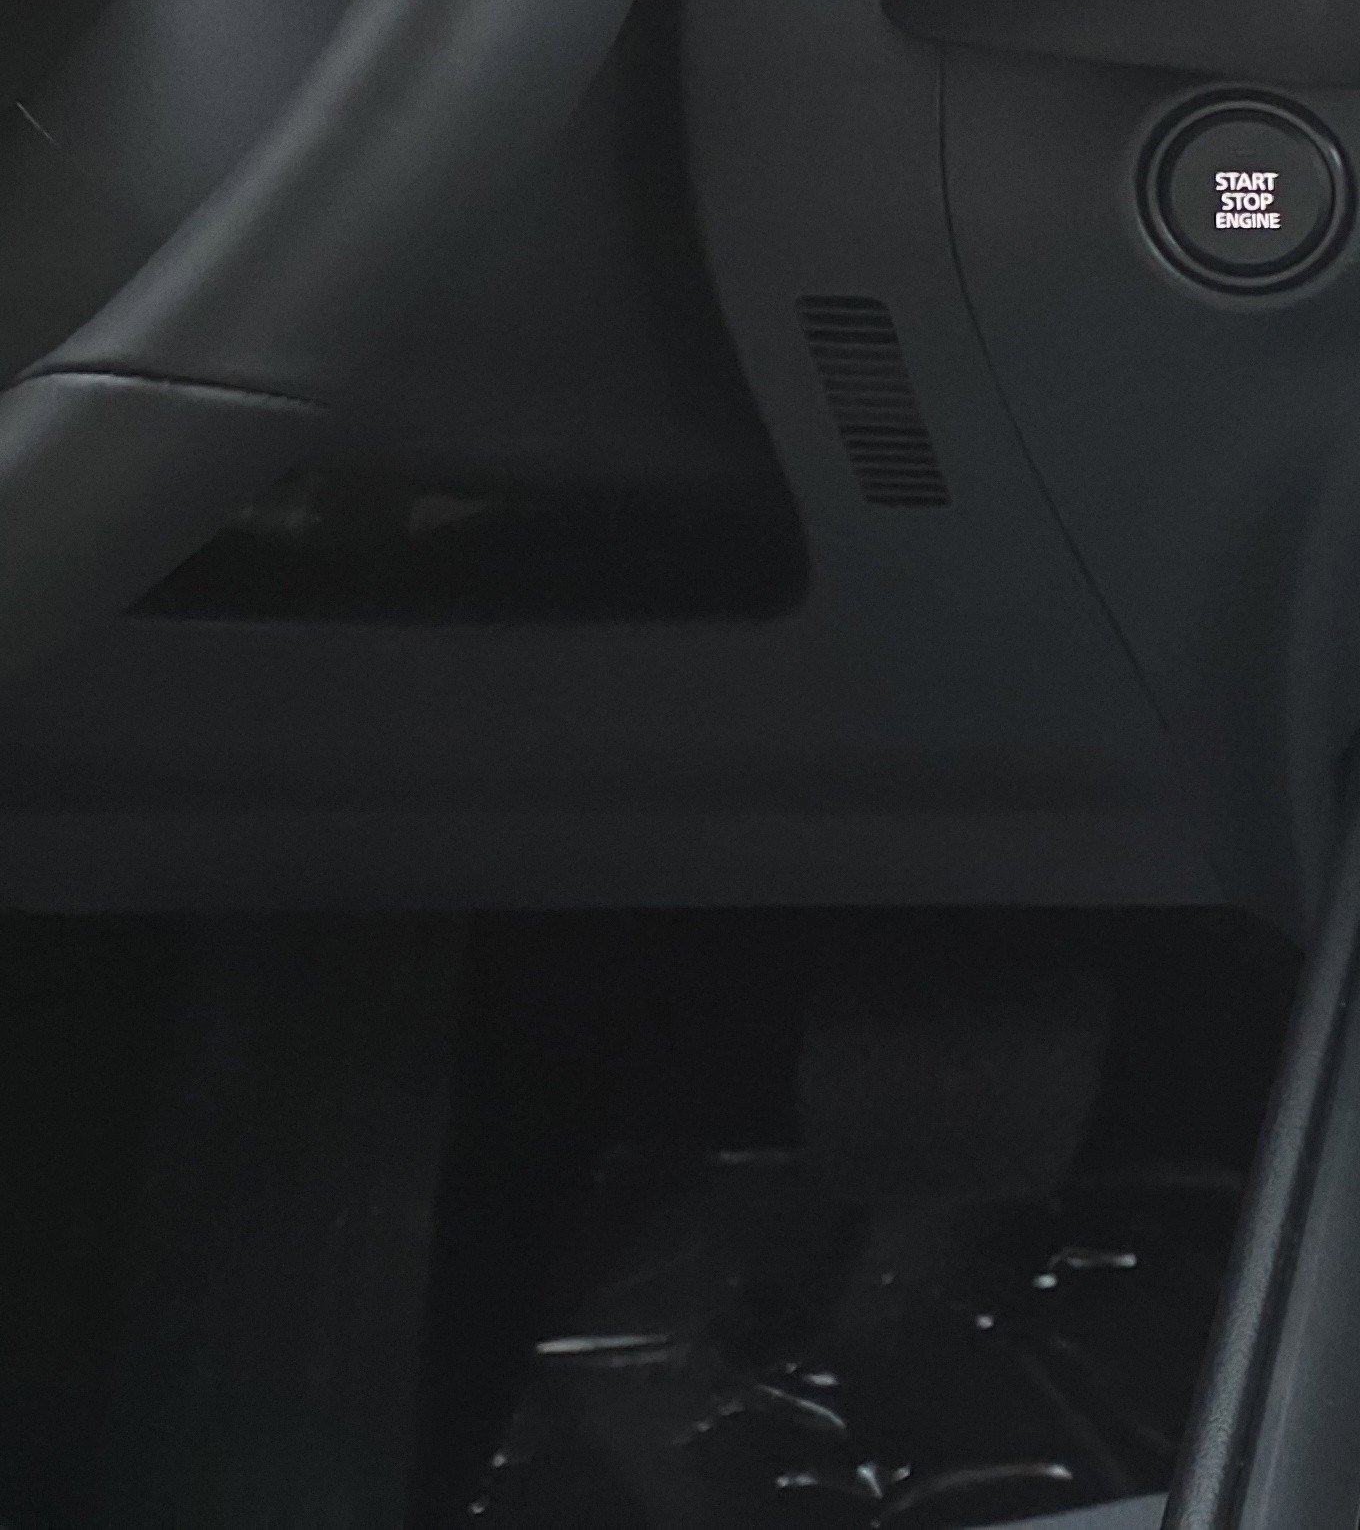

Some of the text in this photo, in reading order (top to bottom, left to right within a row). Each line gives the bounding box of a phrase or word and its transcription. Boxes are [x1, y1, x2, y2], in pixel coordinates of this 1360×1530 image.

[1215, 172, 1279, 191] START
[1221, 192, 1274, 211] STOP
[1215, 212, 1281, 229] ENGINE
